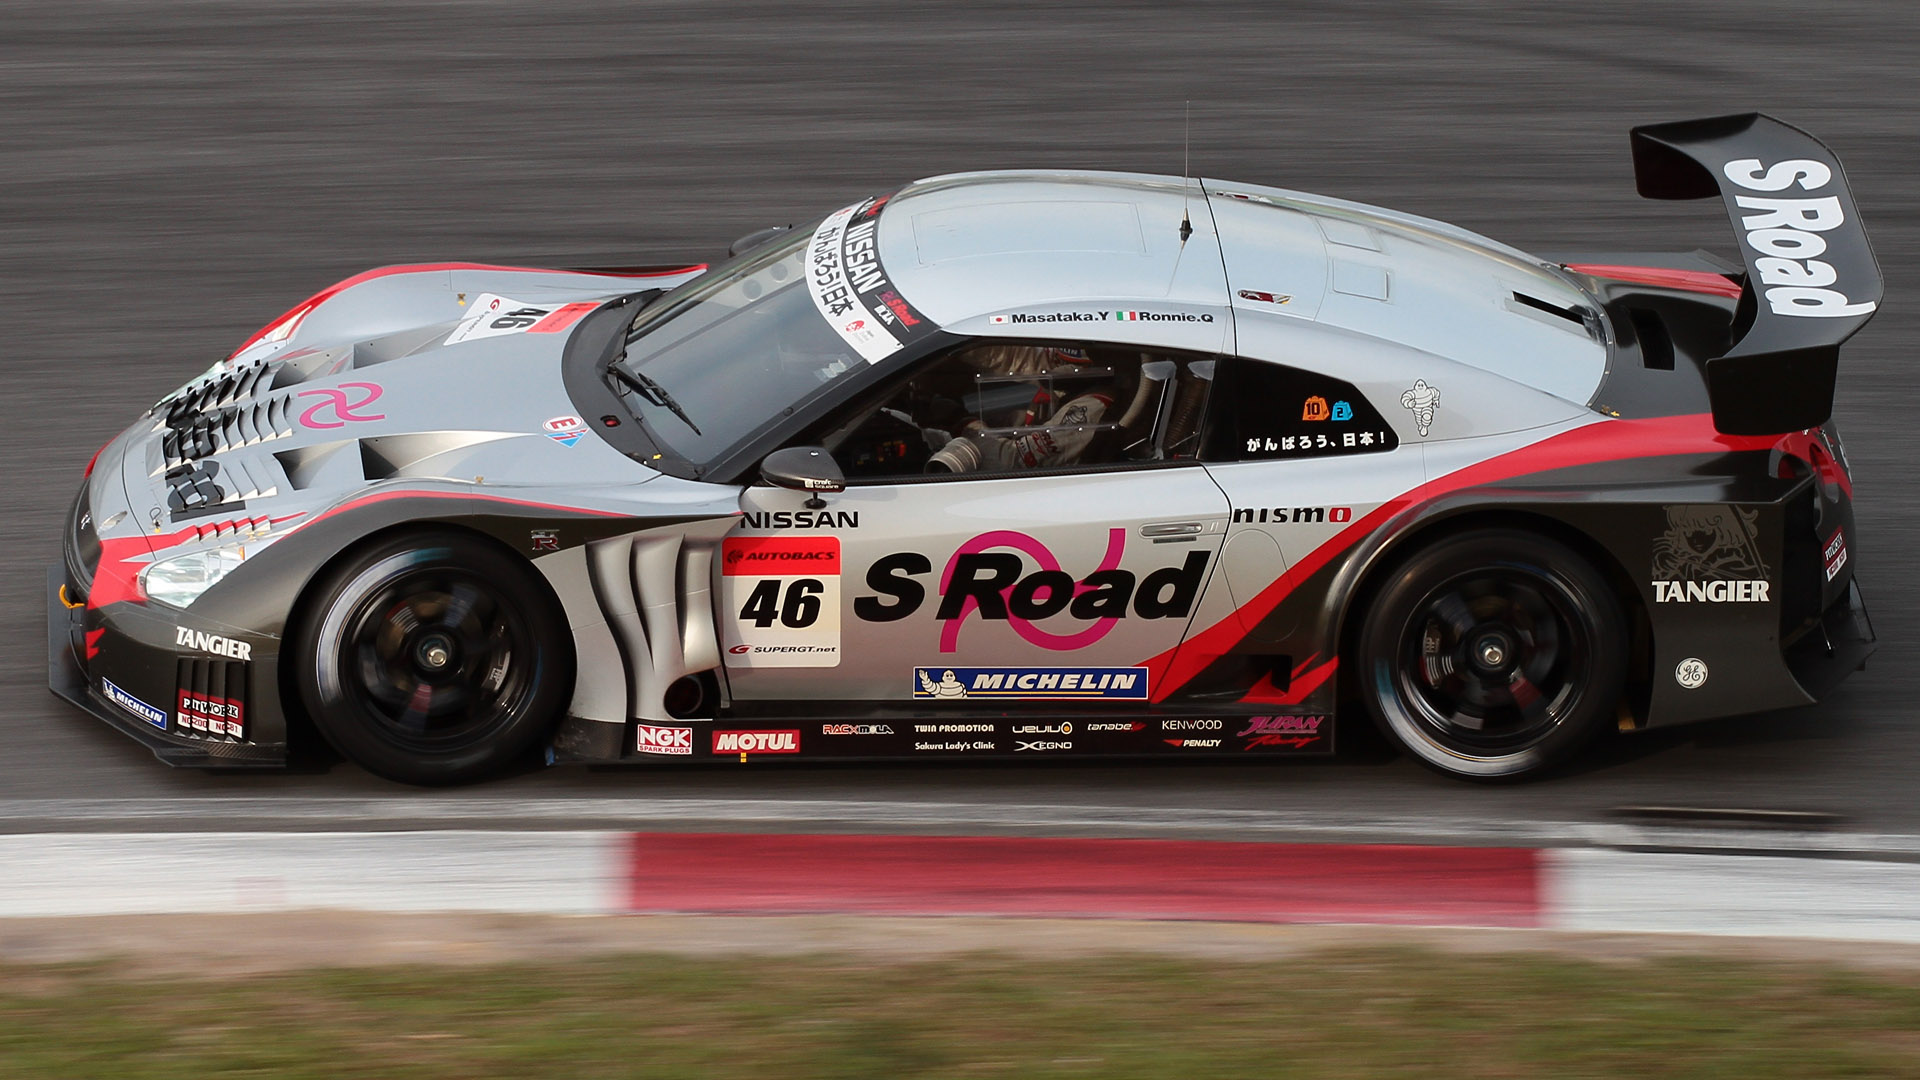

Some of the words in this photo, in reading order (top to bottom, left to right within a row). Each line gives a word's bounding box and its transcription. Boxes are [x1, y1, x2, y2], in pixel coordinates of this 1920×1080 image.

[1723, 158, 1832, 192] S
[845, 219, 888, 295] NISSAN
[1734, 194, 1877, 318] Road
[489, 307, 551, 330] 46
[1011, 311, 1110, 324] Masataka.Y
[1139, 311, 1215, 324] Ronnie.Q
[1306, 402, 1321, 416] 10
[1336, 407, 1344, 418] 2
[739, 511, 860, 529] NISSAN
[1232, 506, 1353, 524] nismo
[745, 551, 836, 561] AUTOBACS
[853, 551, 933, 623] S
[935, 550, 1212, 621] Road
[1651, 579, 1771, 603] TANGIER
[739, 578, 825, 629] 46
[175, 625, 252, 661] TANGIER
[753, 645, 837, 654] SUPERGT.net
[971, 672, 1139, 691] MICHELIN
[115, 691, 164, 724] MICHELIN
[914, 724, 937, 733] TWIN
[938, 724, 995, 733] PROMOTION
[1161, 719, 1223, 730] KENWOOD
[639, 727, 691, 747] NGK
[715, 733, 797, 751] MOTUL
[1013, 740, 1073, 752] XEGNO
[1183, 739, 1222, 748] PENALTY
[639, 745, 664, 753] SPARK
[914, 742, 944, 750] Sakura
[945, 741, 971, 752] Lady's
[972, 741, 995, 750] Clinic
